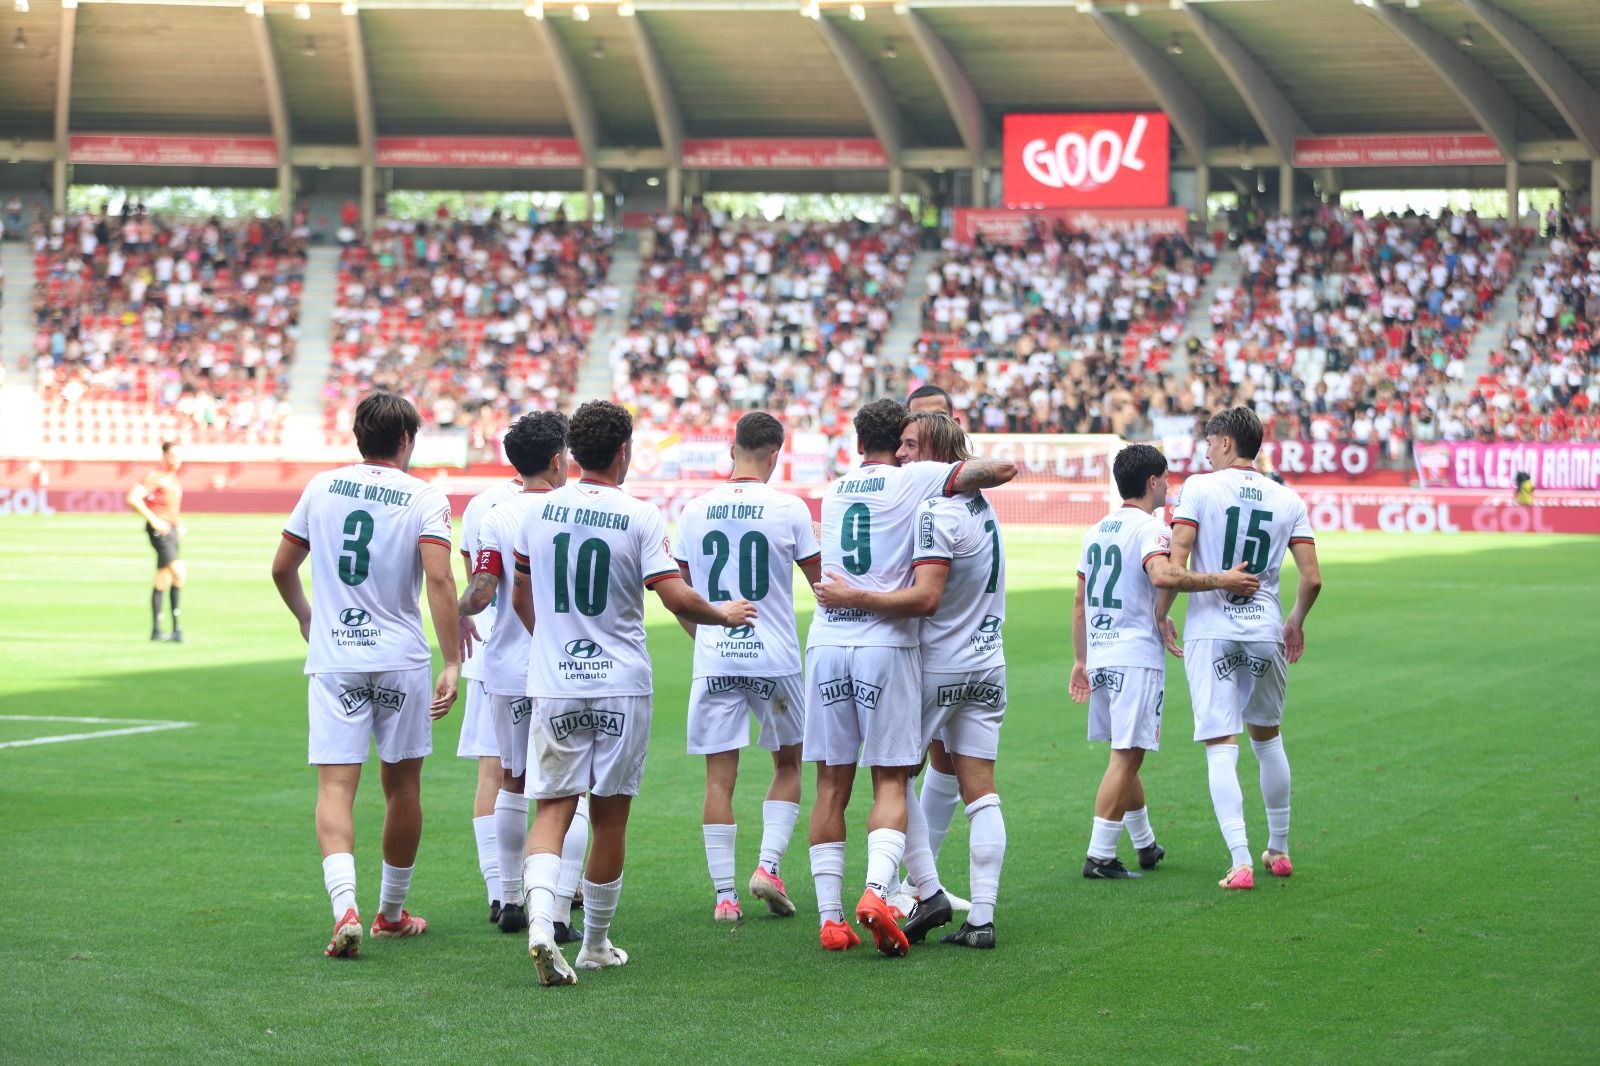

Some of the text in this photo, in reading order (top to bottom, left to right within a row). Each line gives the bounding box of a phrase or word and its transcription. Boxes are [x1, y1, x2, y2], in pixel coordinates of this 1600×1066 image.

[1022, 115, 1148, 188] GOOL
[1455, 447, 1482, 488] EL
[328, 479, 412, 506] JAIME VÁZQUEZ
[1240, 487, 1262, 501] JASO
[541, 501, 570, 523] ÁLEX
[574, 508, 630, 531] CARDERO
[706, 502, 764, 520] IAGO LÓPEZ
[1310, 502, 1553, 533] OL GOL GOL
[339, 510, 374, 586] 3
[840, 503, 872, 576] 9
[1222, 506, 1273, 573] 15
[553, 532, 611, 617] 10
[702, 530, 769, 602] 20
[1086, 543, 1122, 609] 22
[332, 629, 381, 638] HYUNDAI
[716, 642, 764, 650] HYUNDAI
[1089, 632, 1119, 640] YUNDAI
[559, 661, 613, 670] HYUNDAI
[344, 687, 400, 710] HIJOUSA
[821, 682, 875, 704] HIJOUSA
[942, 685, 1000, 703] HIJLUSA
[556, 712, 618, 735] HIJOUSA
